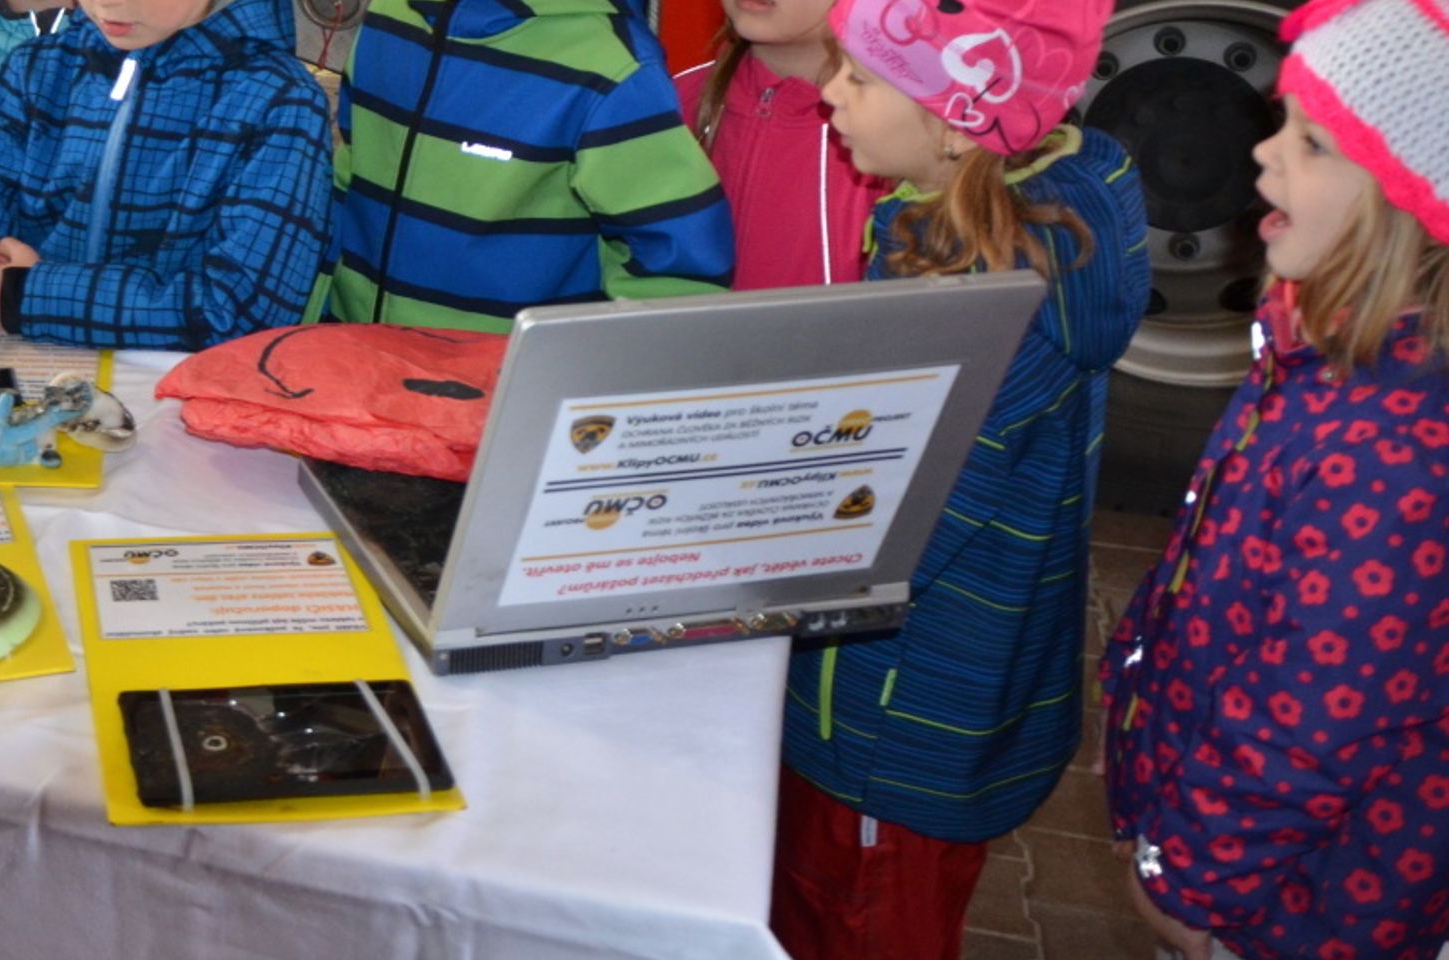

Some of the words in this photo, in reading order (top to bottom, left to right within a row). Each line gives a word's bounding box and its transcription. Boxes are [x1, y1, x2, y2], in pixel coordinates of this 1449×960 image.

[791, 425, 873, 448] OČMU
[584, 494, 667, 516] OČMU
[616, 559, 633, 568] se
[637, 552, 701, 566] Nebojte
[733, 563, 759, 577] jak
